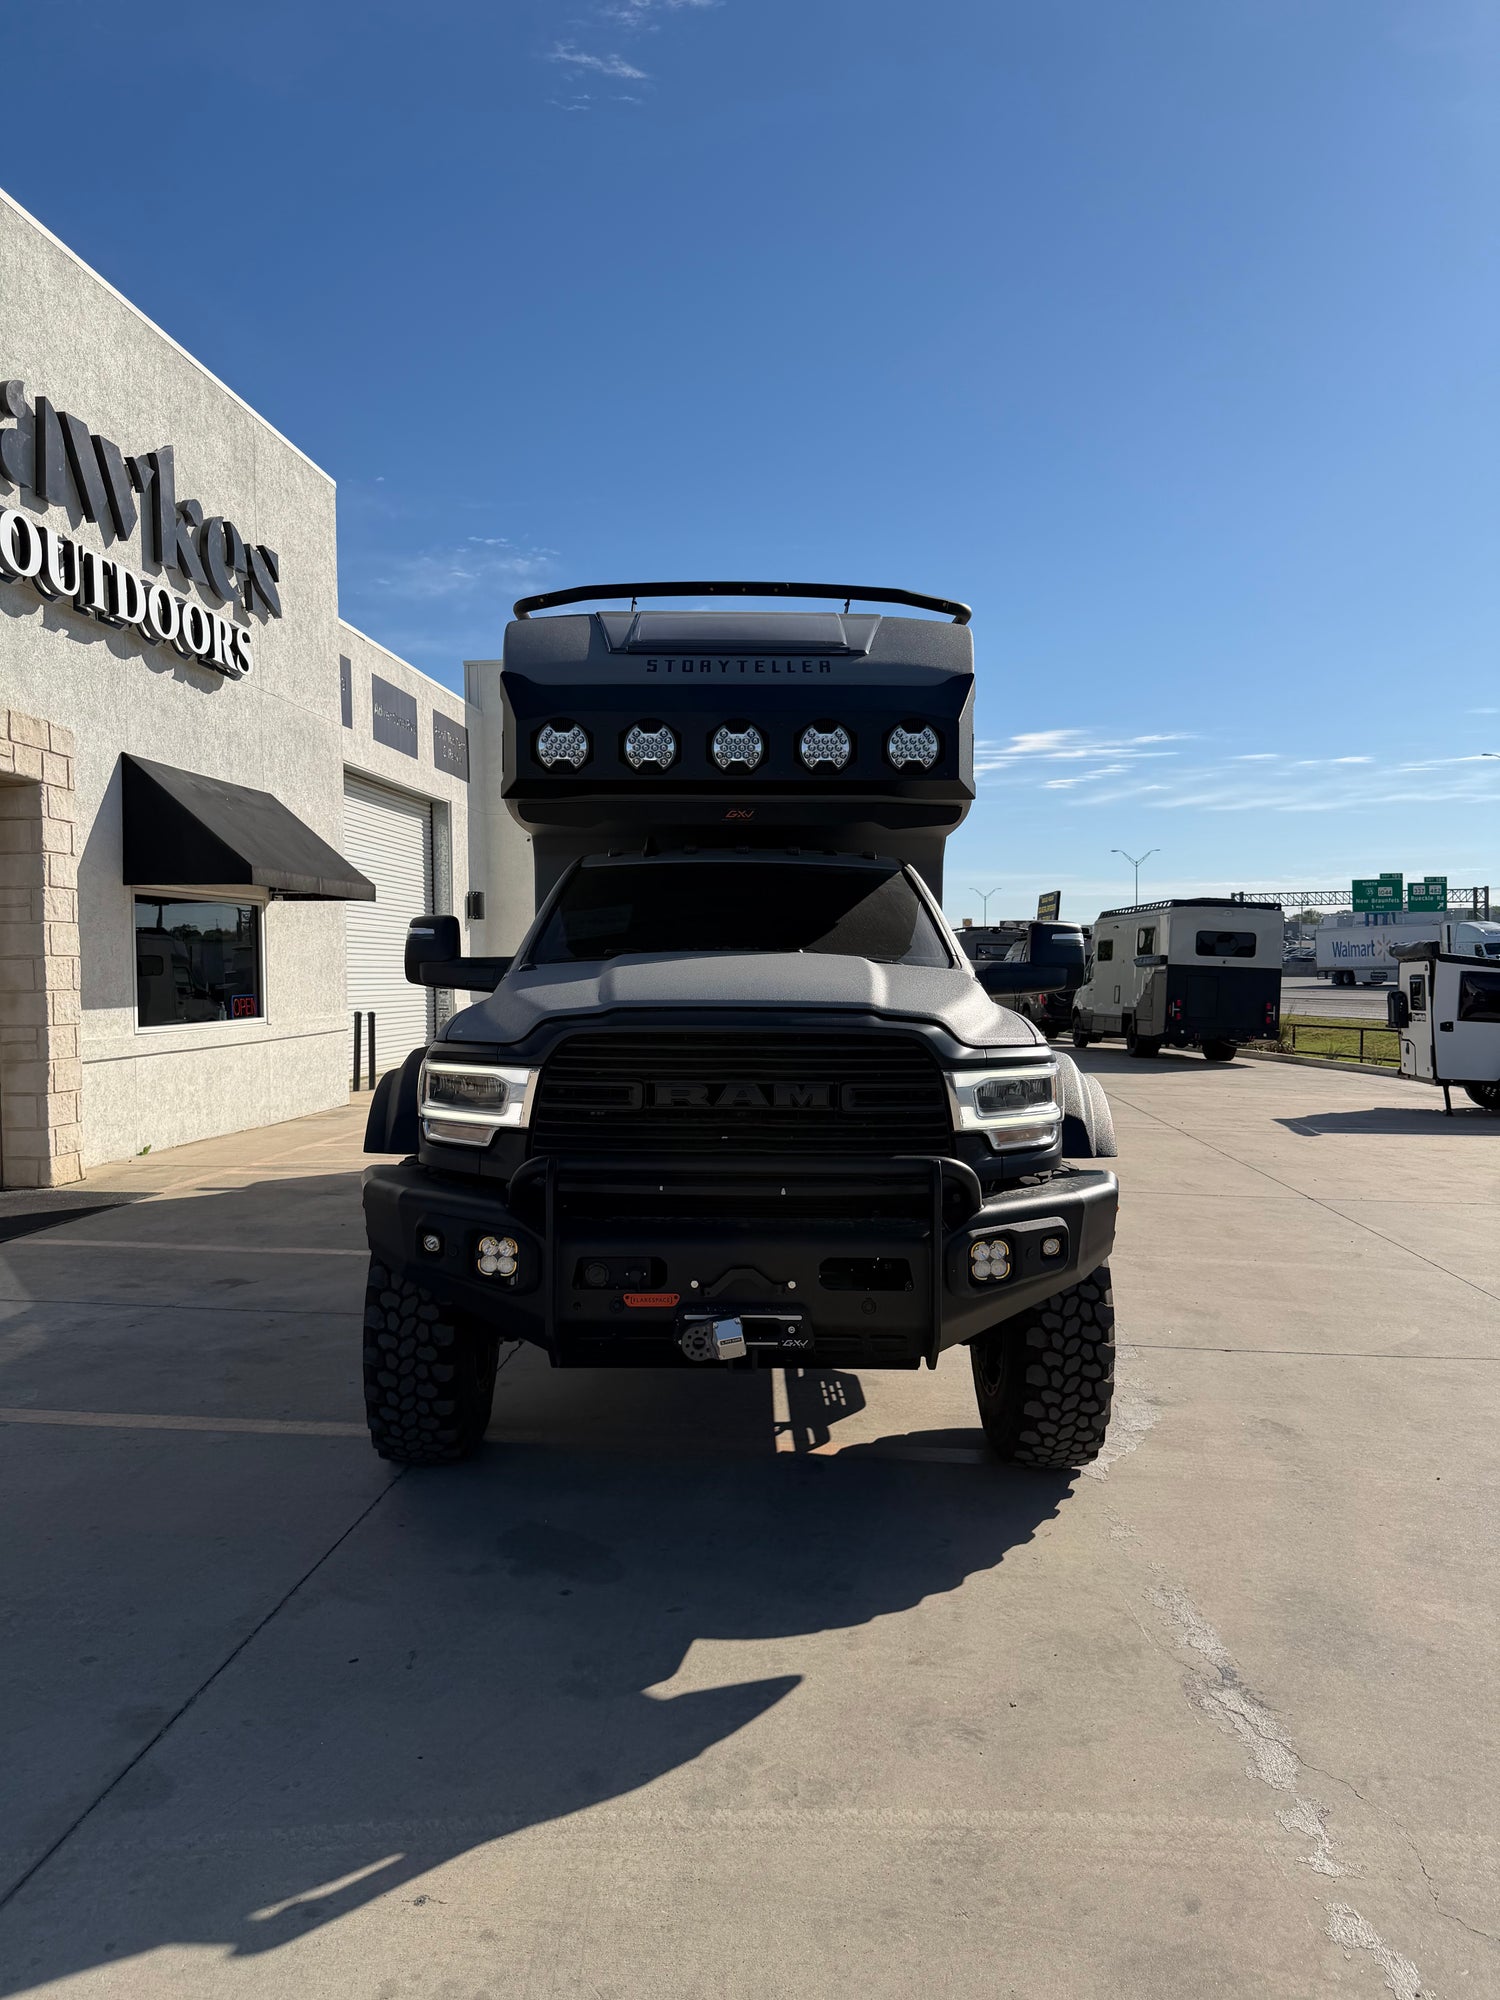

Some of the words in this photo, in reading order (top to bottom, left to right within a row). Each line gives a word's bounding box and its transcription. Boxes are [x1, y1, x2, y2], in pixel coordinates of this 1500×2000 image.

[0, 509, 252, 676] OUTDOORS
[646, 659, 831, 673] STORYTELLER
[724, 809, 755, 819] GXV
[1332, 940, 1375, 957] Walmart
[233, 997, 256, 1016] OPEN
[655, 1080, 829, 1108] RAM
